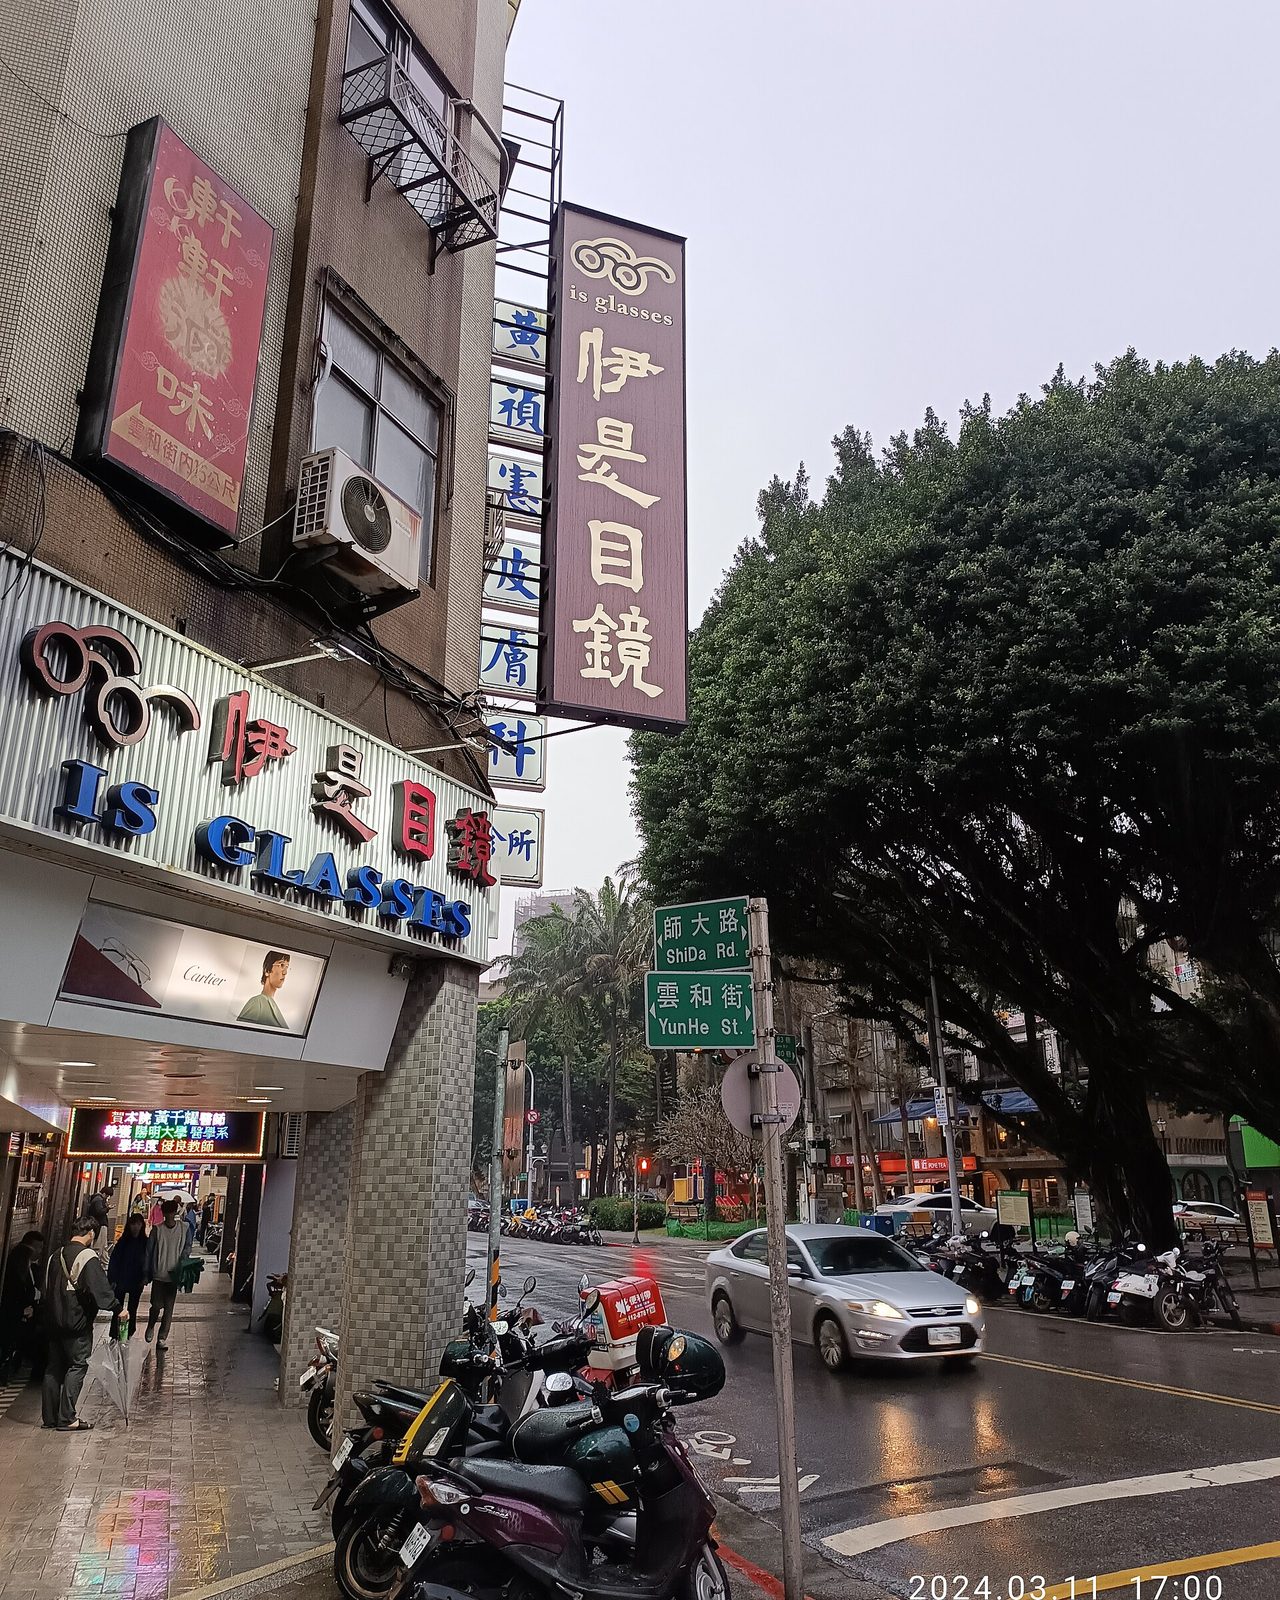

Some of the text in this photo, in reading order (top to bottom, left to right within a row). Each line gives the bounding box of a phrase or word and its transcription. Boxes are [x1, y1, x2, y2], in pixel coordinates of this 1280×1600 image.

[569, 285, 674, 327] is glasses
[572, 327, 664, 698] 伊是目鏡
[209, 689, 497, 887] 伊是目鏡
[54, 758, 472, 940] IS GLASSES
[663, 907, 740, 941] 師大路
[666, 942, 739, 964] ShiDa Rd.
[183, 964, 227, 987] Cartier
[657, 981, 744, 1009] 雲和街
[658, 1018, 743, 1035] YunHe St.
